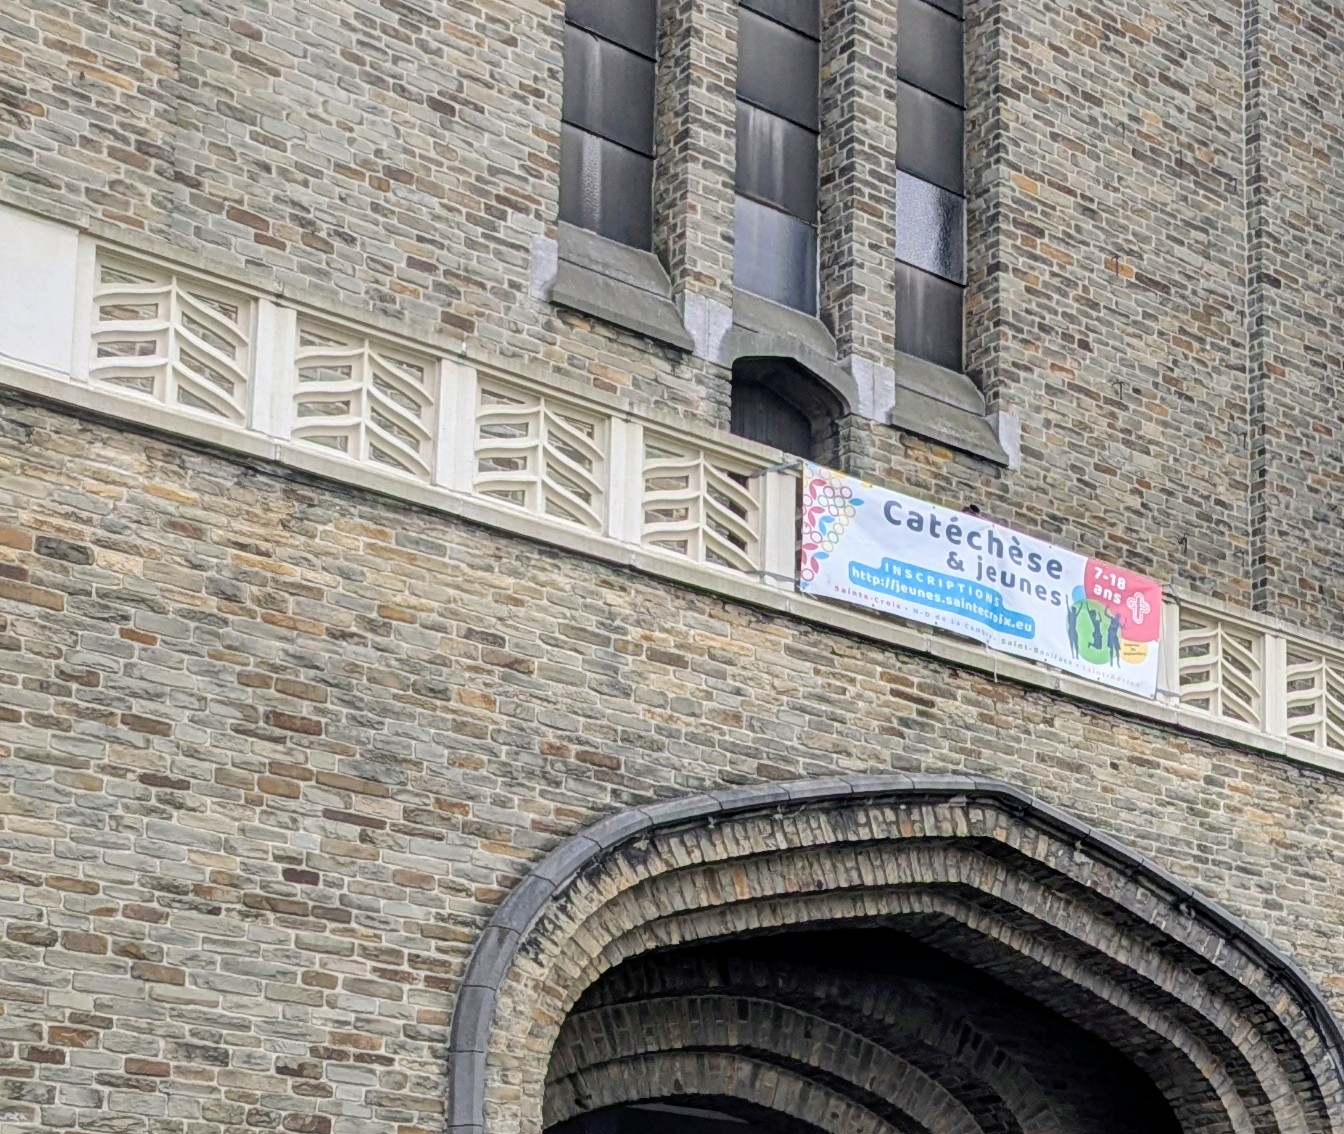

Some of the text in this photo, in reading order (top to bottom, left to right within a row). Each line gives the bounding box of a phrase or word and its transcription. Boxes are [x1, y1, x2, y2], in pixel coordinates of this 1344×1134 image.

[883, 500, 1063, 580] Catéchèse
[852, 566, 1032, 632] http://jeunes.saintecroix.eu
[885, 562, 1000, 607] INSCRIPTIONS
[946, 551, 1061, 607] & jeunes
[1093, 566, 1126, 590] 7-18
[1093, 584, 1122, 604] ans
